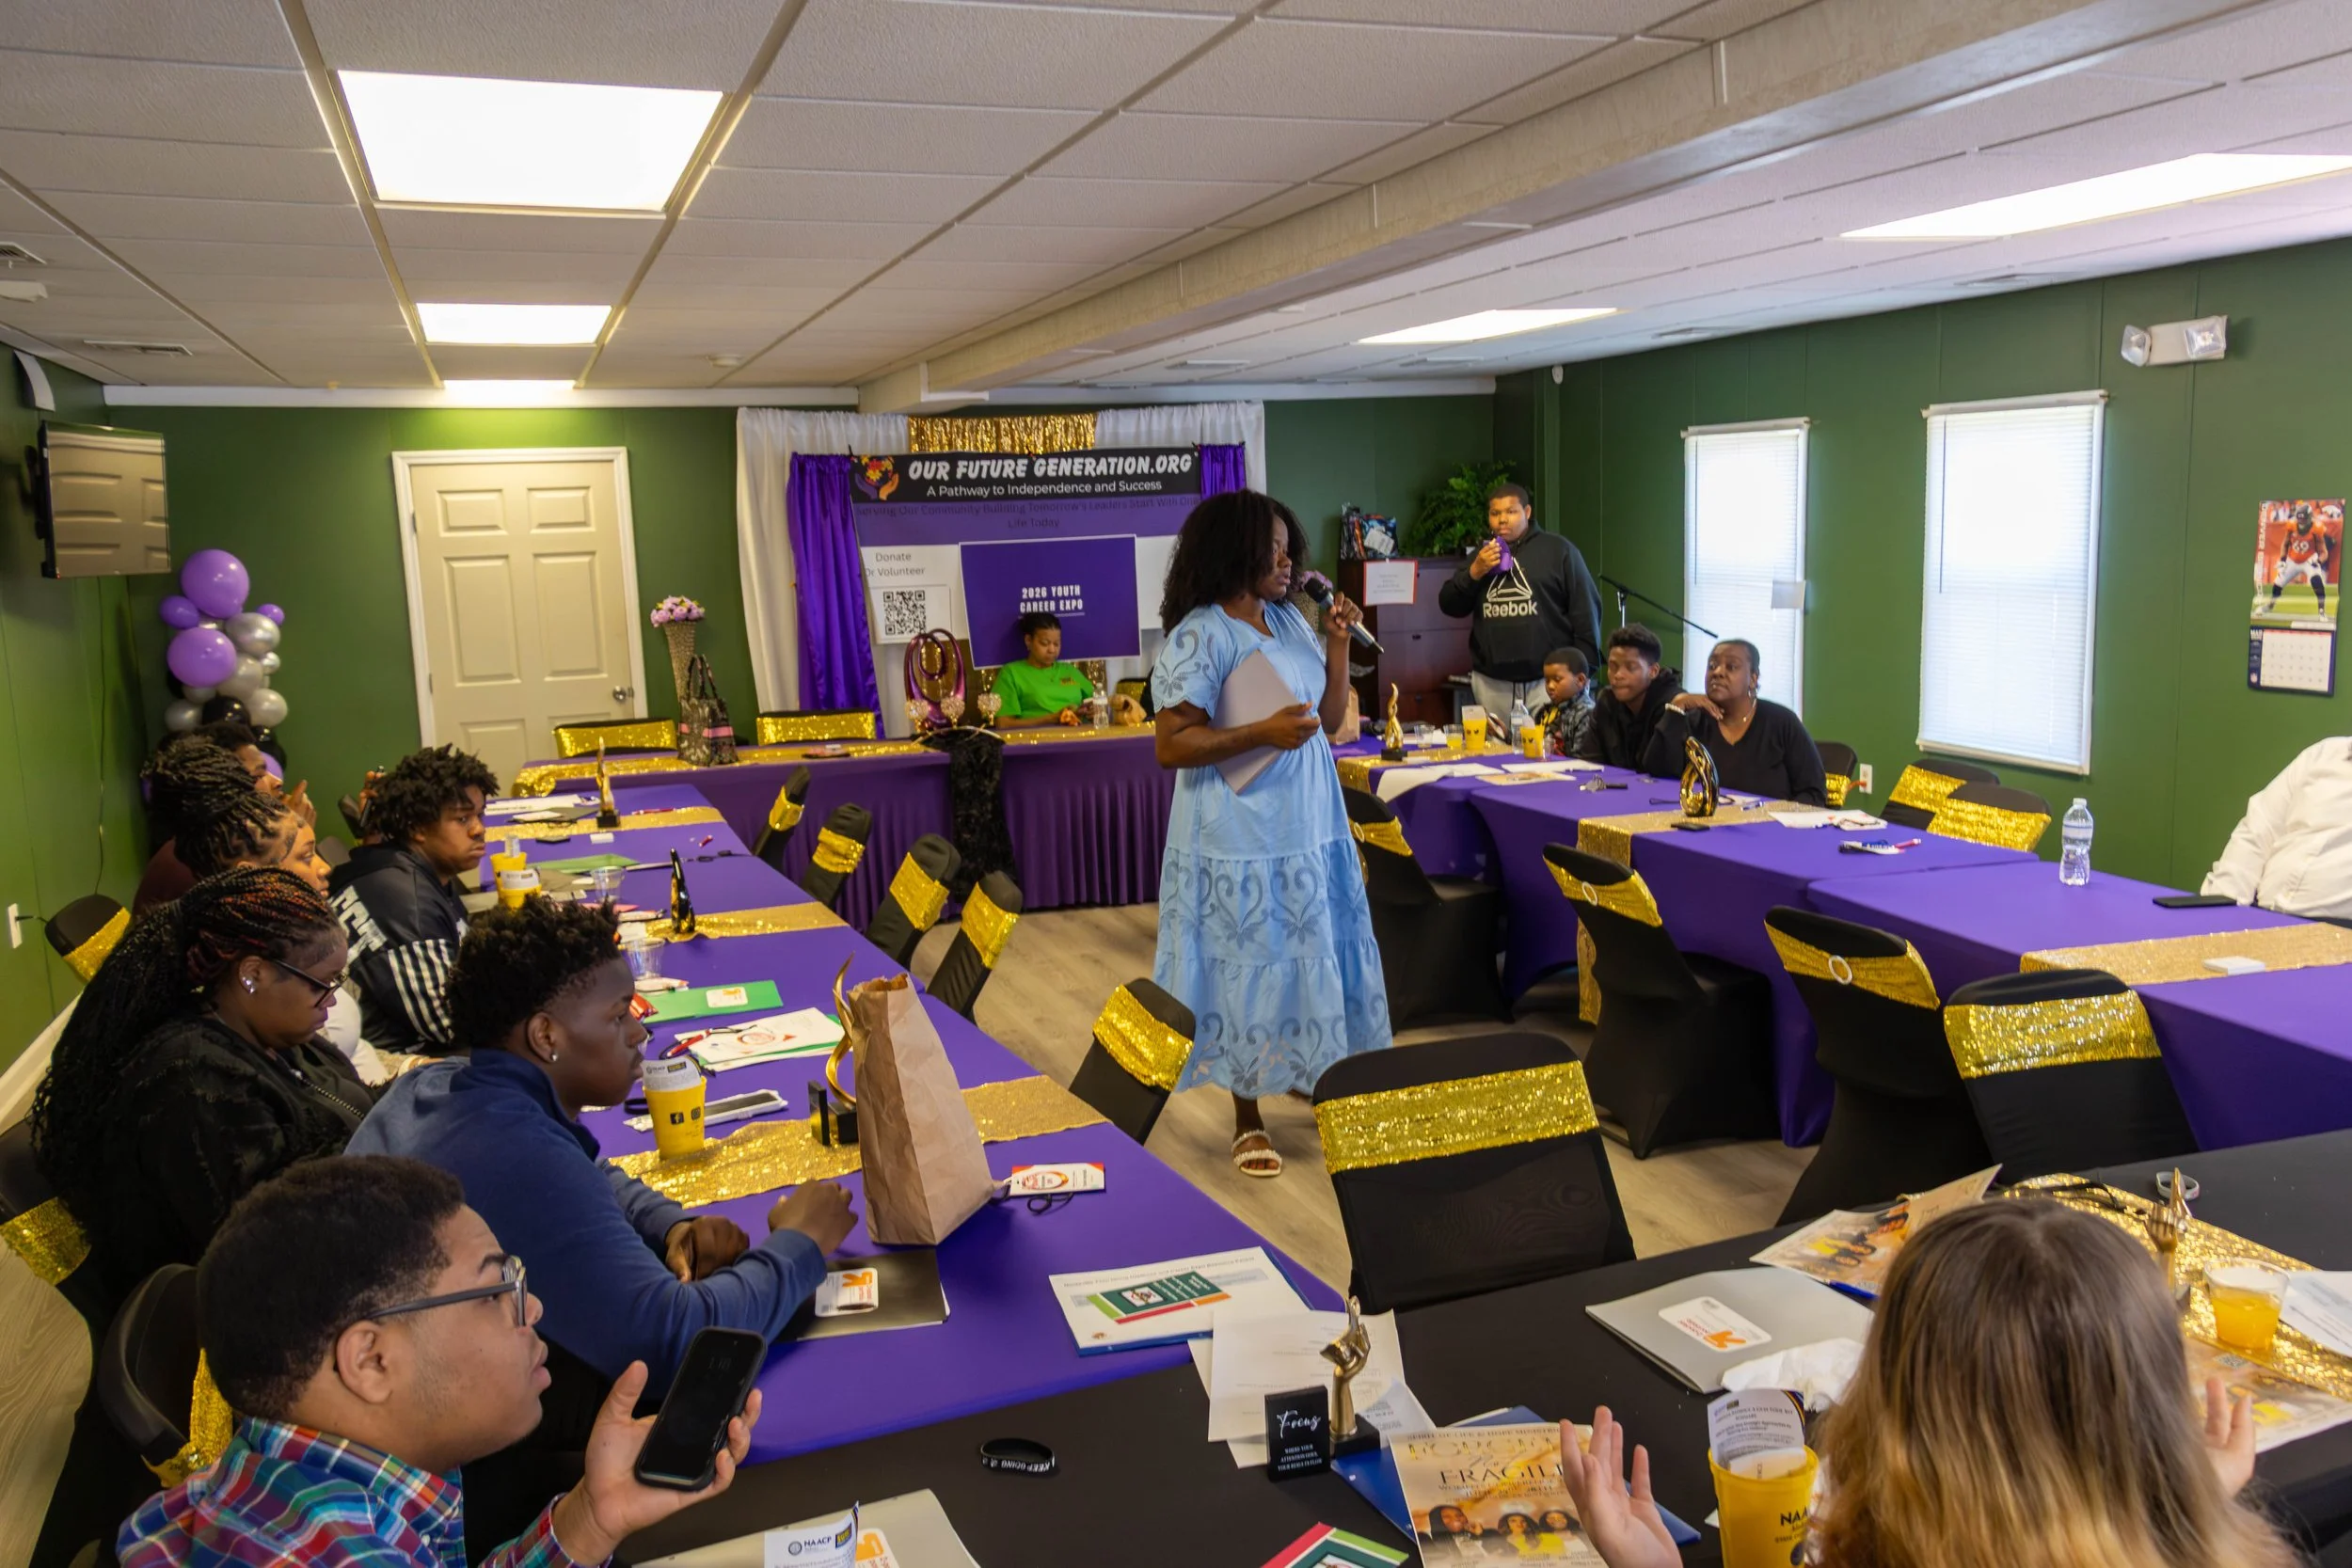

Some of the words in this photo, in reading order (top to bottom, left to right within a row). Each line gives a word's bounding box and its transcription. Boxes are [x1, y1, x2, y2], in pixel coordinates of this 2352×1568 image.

[908, 460, 950, 481] OUR
[956, 459, 1028, 480] FUTURE
[1033, 453, 1192, 477] GENERATION.ORG
[927, 485, 936, 497] A
[939, 484, 989, 499] Pathway
[993, 485, 1004, 496] to
[1008, 482, 1092, 497] Independence
[1095, 481, 1116, 492] and
[1119, 479, 1162, 491] Success
[899, 505, 919, 515] Our
[922, 504, 980, 516] Community
[984, 503, 1026, 515] Building
[1028, 501, 1086, 512] Tomorrow's
[1089, 499, 1127, 510] Leaders
[1129, 499, 1153, 508] Start
[1157, 497, 1176, 507] With
[1008, 520, 1027, 529] Life
[1031, 518, 1059, 529] Today
[875, 552, 911, 562] Donate
[877, 567, 926, 577] Volunteer
[1022, 586, 1047, 599] 2026
[1051, 585, 1081, 597] YOUTH
[1020, 601, 1055, 613] CAREER
[1060, 599, 1083, 611] EXPO
[1483, 600, 1538, 619] Reebok
[1276, 1410, 1321, 1439] Focus
[1001, 1459, 1026, 1470] GOING
[1027, 1461, 1050, 1472] KEEP
[1440, 1463, 1563, 1484] FRAGIL
[804, 1536, 832, 1547] NAACP
